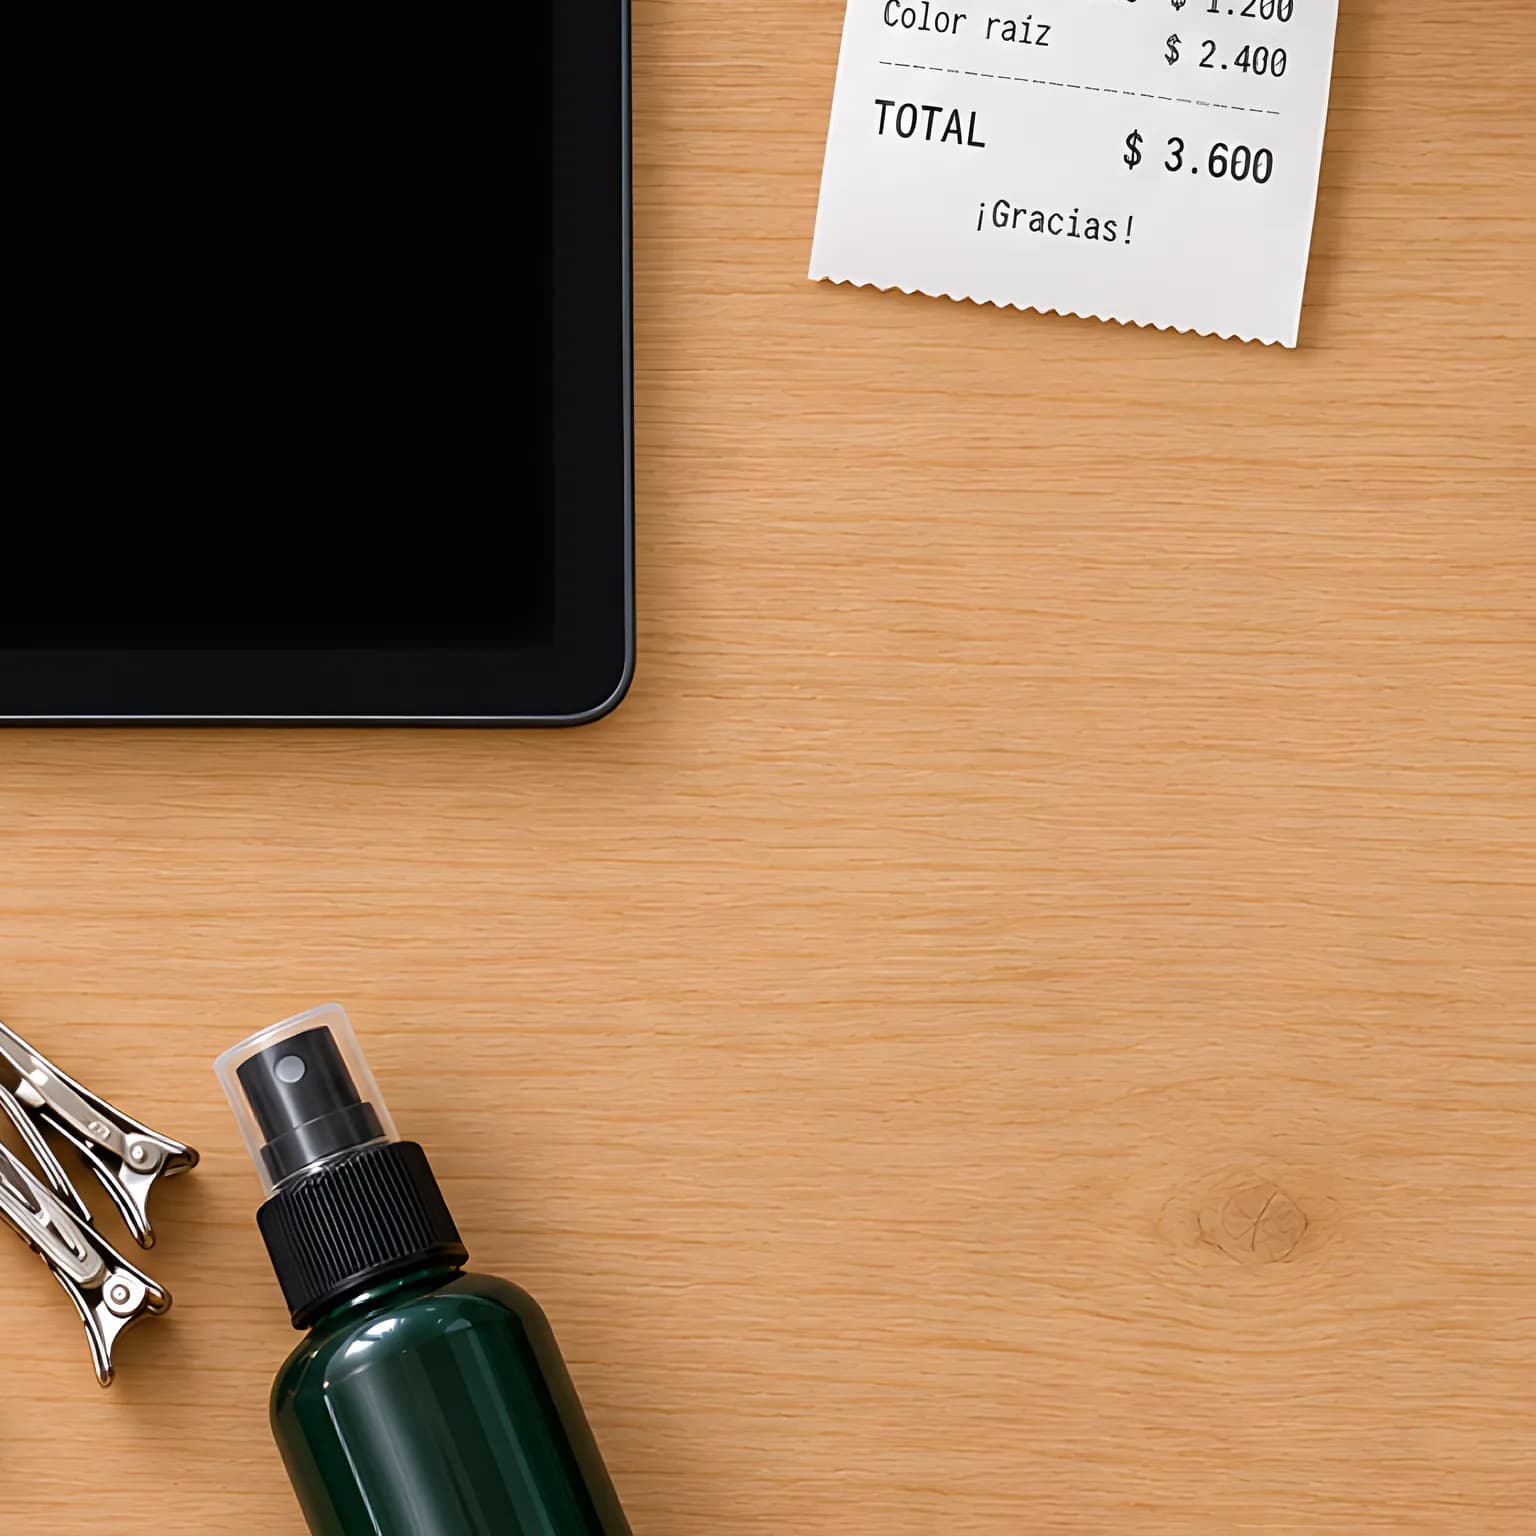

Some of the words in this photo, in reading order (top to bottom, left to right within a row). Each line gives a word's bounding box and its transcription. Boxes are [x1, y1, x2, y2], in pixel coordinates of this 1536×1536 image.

[1164, 33, 1182, 66] $
[1198, 39, 1287, 78] 2.400
[874, 98, 986, 148] TOTAL
[1123, 128, 1144, 171] $
[1164, 136, 1274, 185] 3.600
[976, 199, 1133, 245] ¡Gracias!
